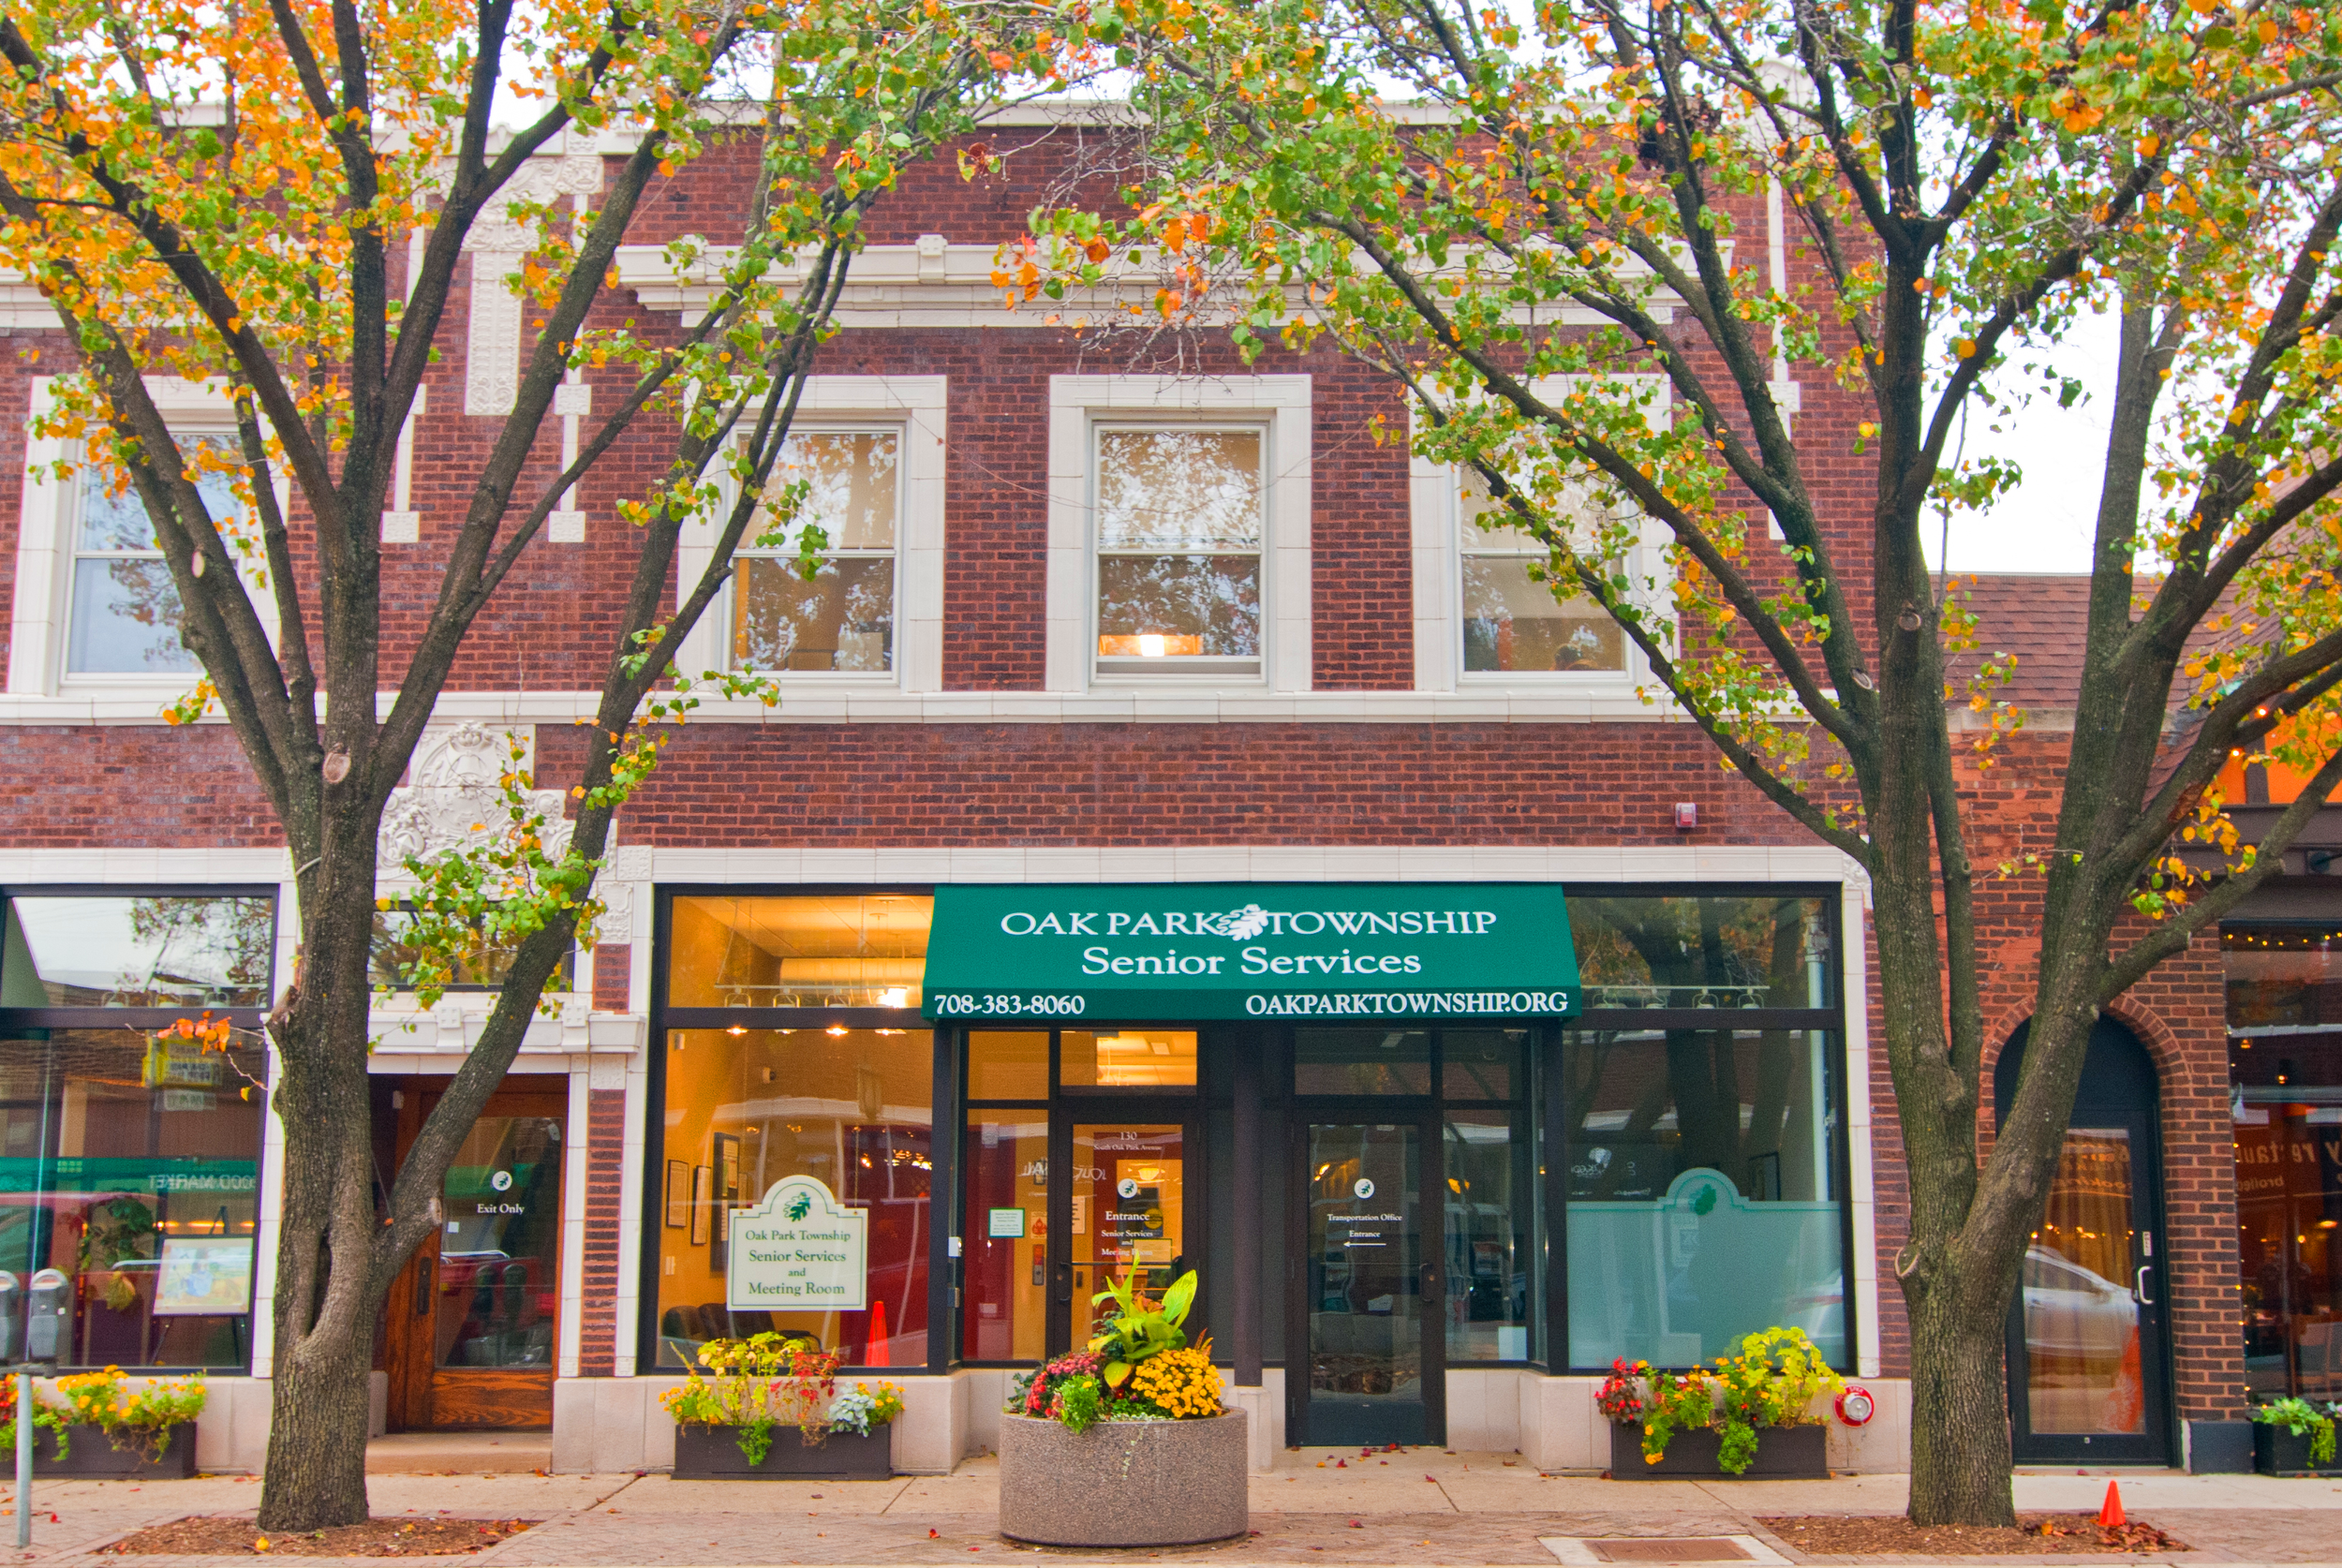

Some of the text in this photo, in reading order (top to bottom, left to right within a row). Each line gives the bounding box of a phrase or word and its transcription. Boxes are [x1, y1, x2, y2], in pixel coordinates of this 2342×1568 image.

[1001, 910, 1497, 935] OAK PARK TOWNSHIP
[1082, 946, 1422, 975] Senior Services
[934, 994, 1086, 1014] 708-383-8060
[1245, 992, 1569, 1014] OAKPARKTOWNSHIP.ORG
[1120, 1132, 1137, 1140] 130
[477, 1203, 525, 1215] Exit Only
[1105, 1210, 1150, 1220] Entrance
[1327, 1213, 1379, 1221] Transportation
[745, 1229, 851, 1242] Oak Park Township
[1101, 1229, 1153, 1237] Senior Services
[1349, 1229, 1381, 1237] Entrance
[749, 1249, 847, 1262] Senior Services
[788, 1266, 807, 1277] and
[749, 1281, 845, 1296] Meeting Room
